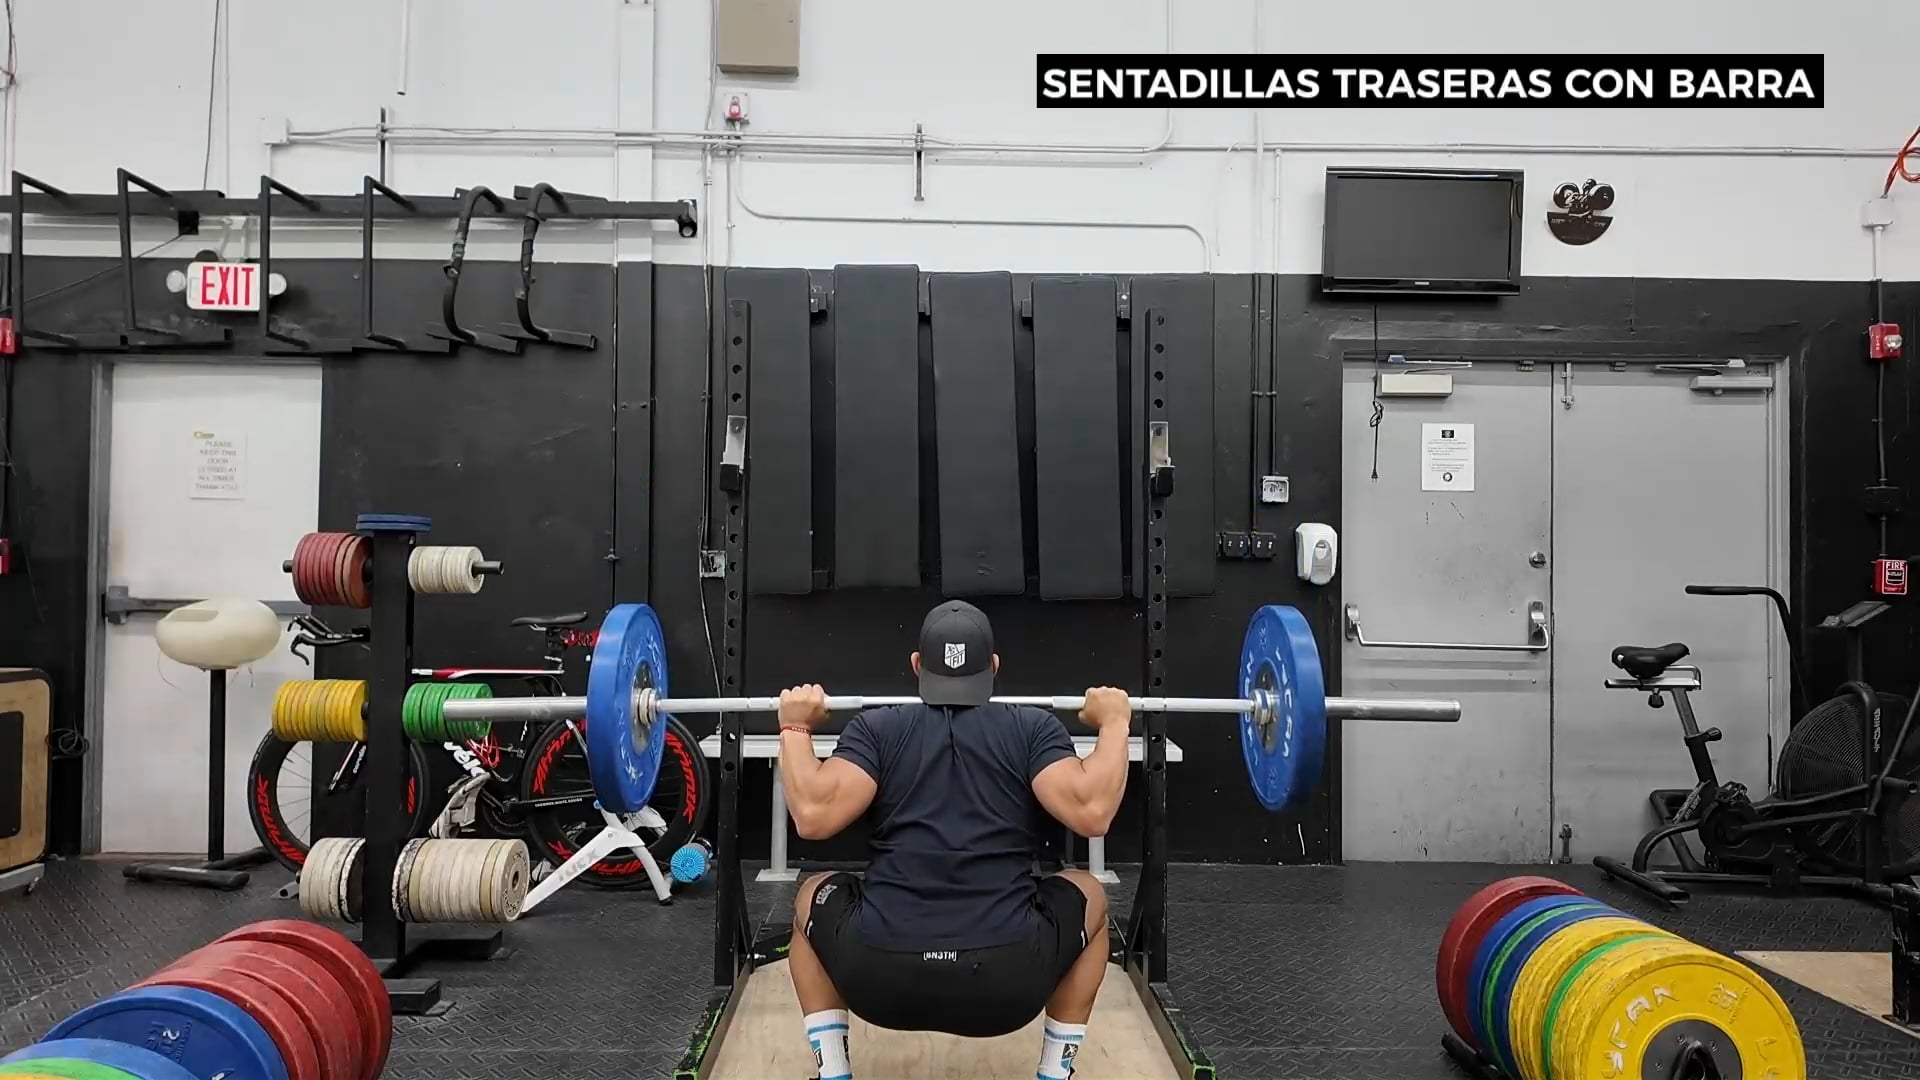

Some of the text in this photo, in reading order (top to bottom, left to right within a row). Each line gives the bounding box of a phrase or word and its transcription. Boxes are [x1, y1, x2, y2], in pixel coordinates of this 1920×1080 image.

[202, 266, 254, 305] EXIT
[1886, 561, 1905, 569] FIRE
[952, 653, 963, 667] FIT
